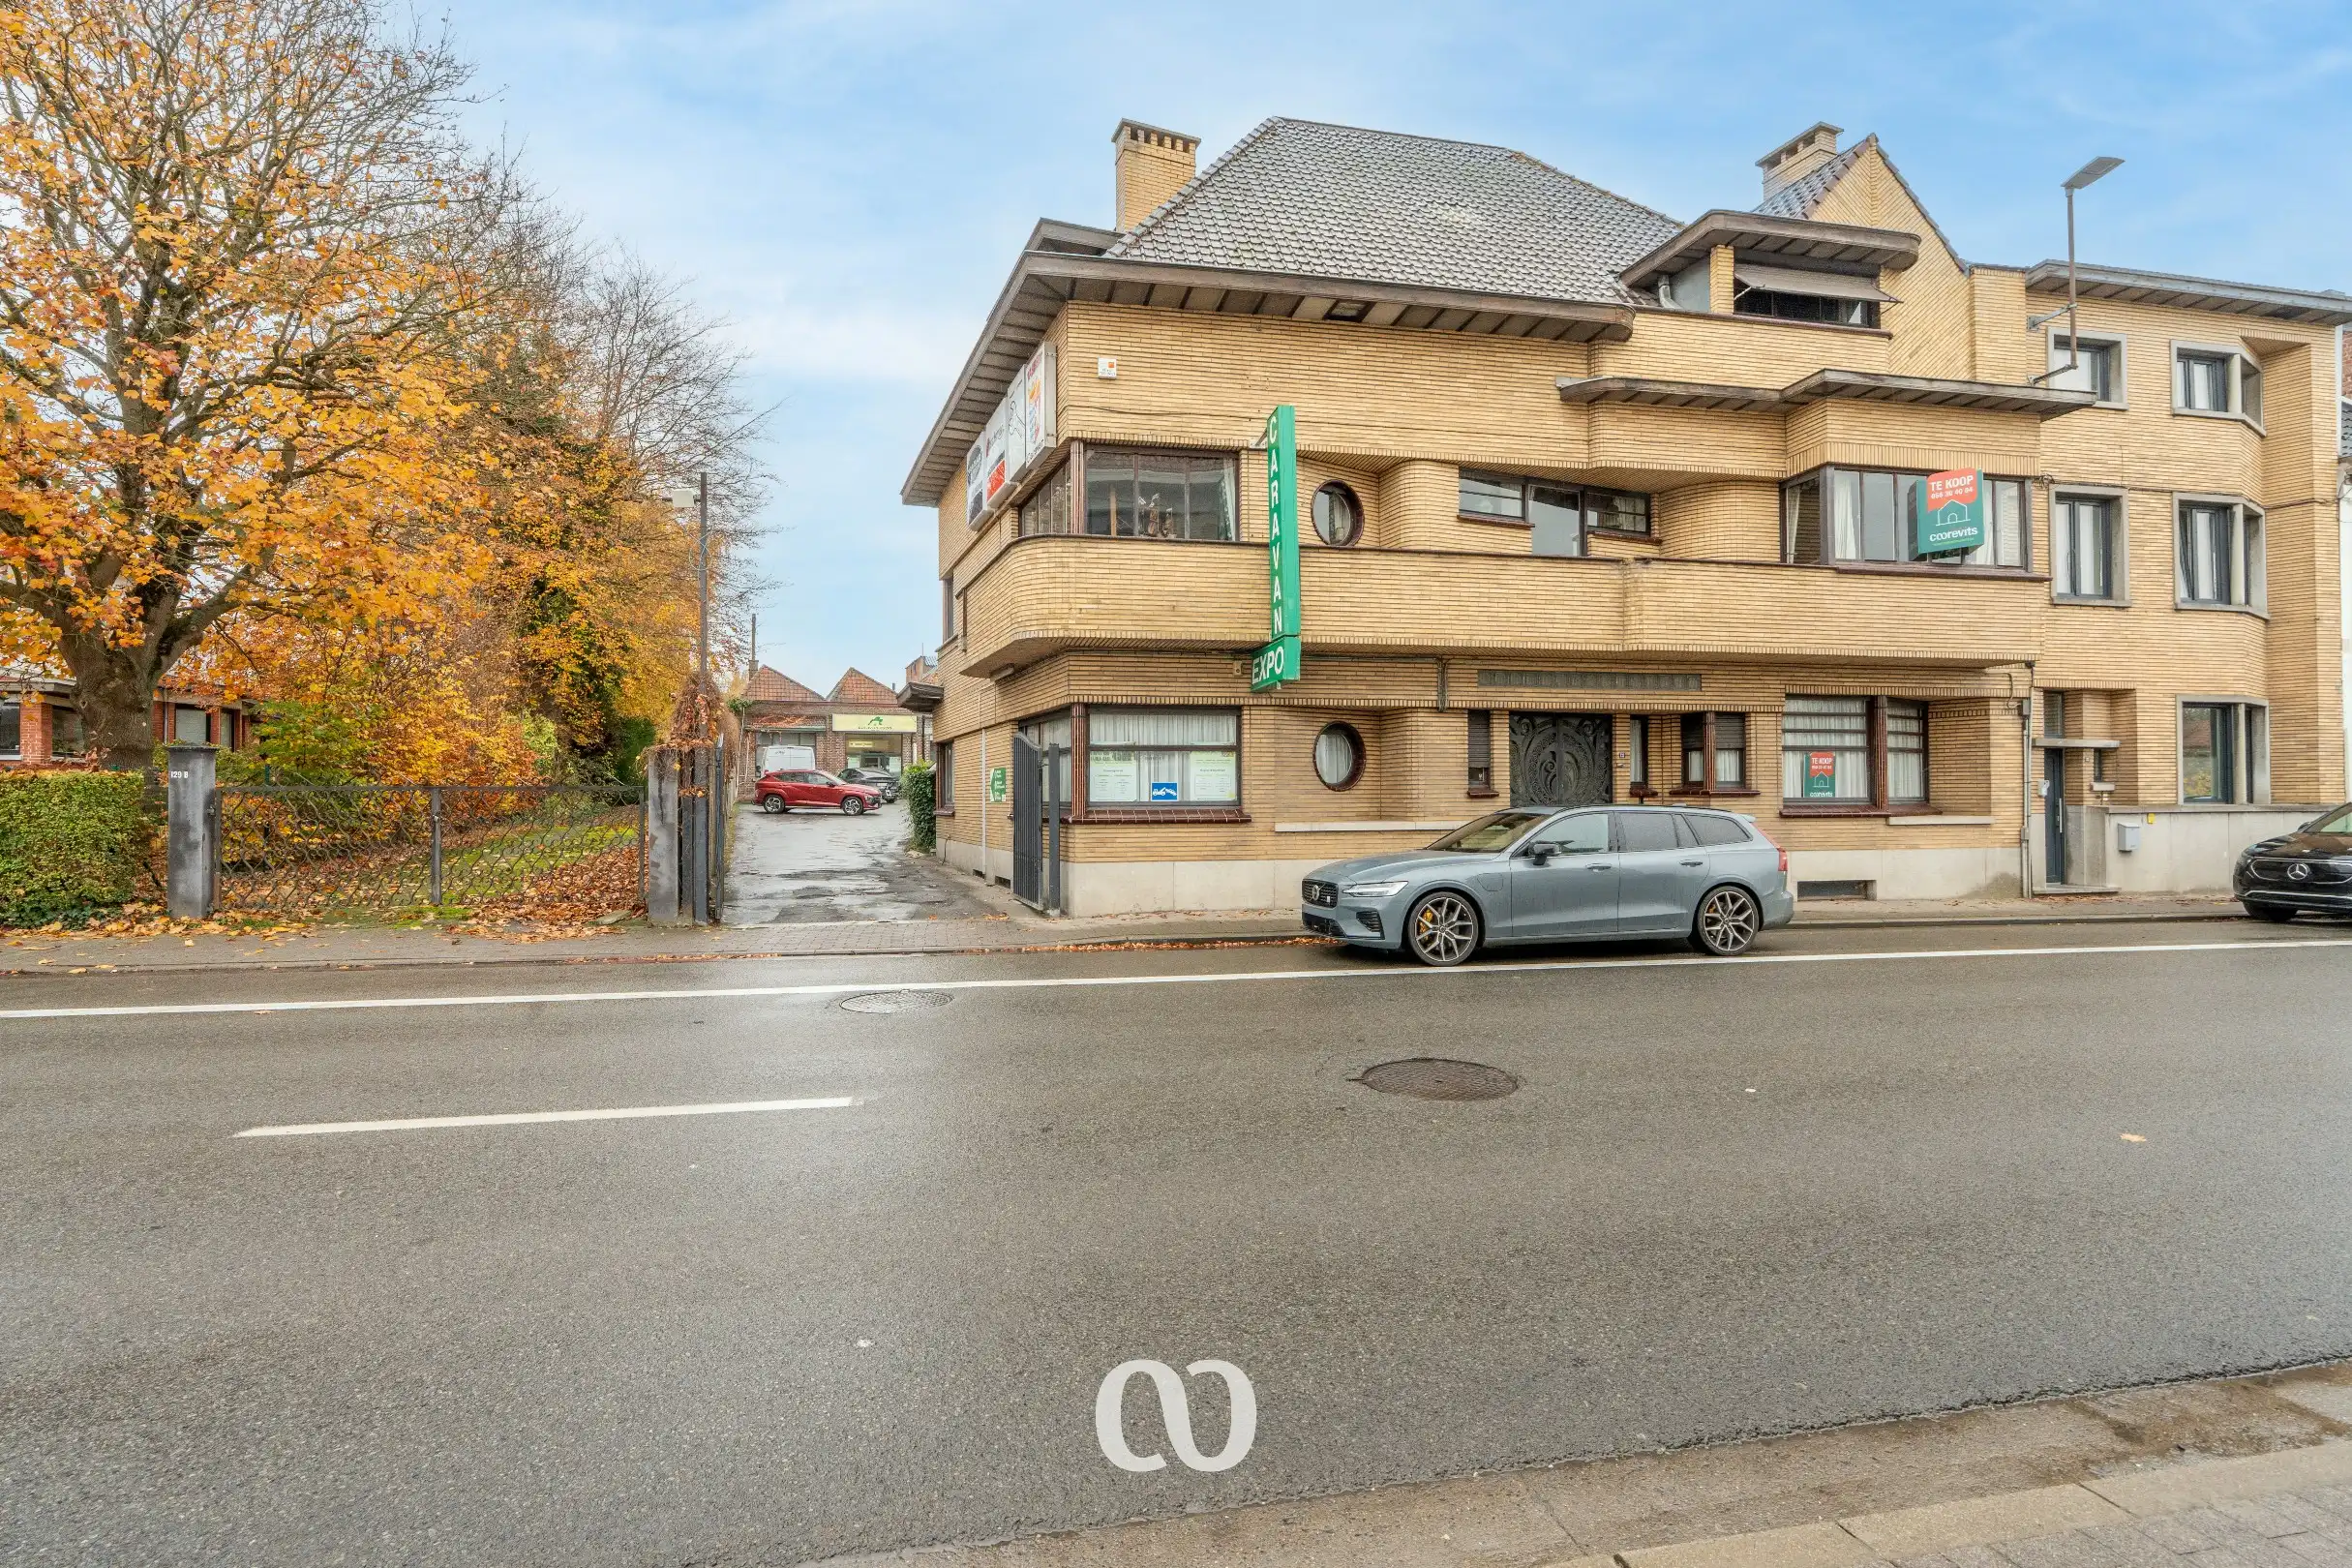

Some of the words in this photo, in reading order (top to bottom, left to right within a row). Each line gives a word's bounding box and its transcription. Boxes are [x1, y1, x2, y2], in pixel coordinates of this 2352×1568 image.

[1929, 481, 1943, 491] TE
[1945, 475, 1974, 489] KOOP
[1269, 415, 1282, 635] CARAVAN
[1929, 527, 1978, 542] coorevits
[1251, 646, 1284, 684] EXPO
